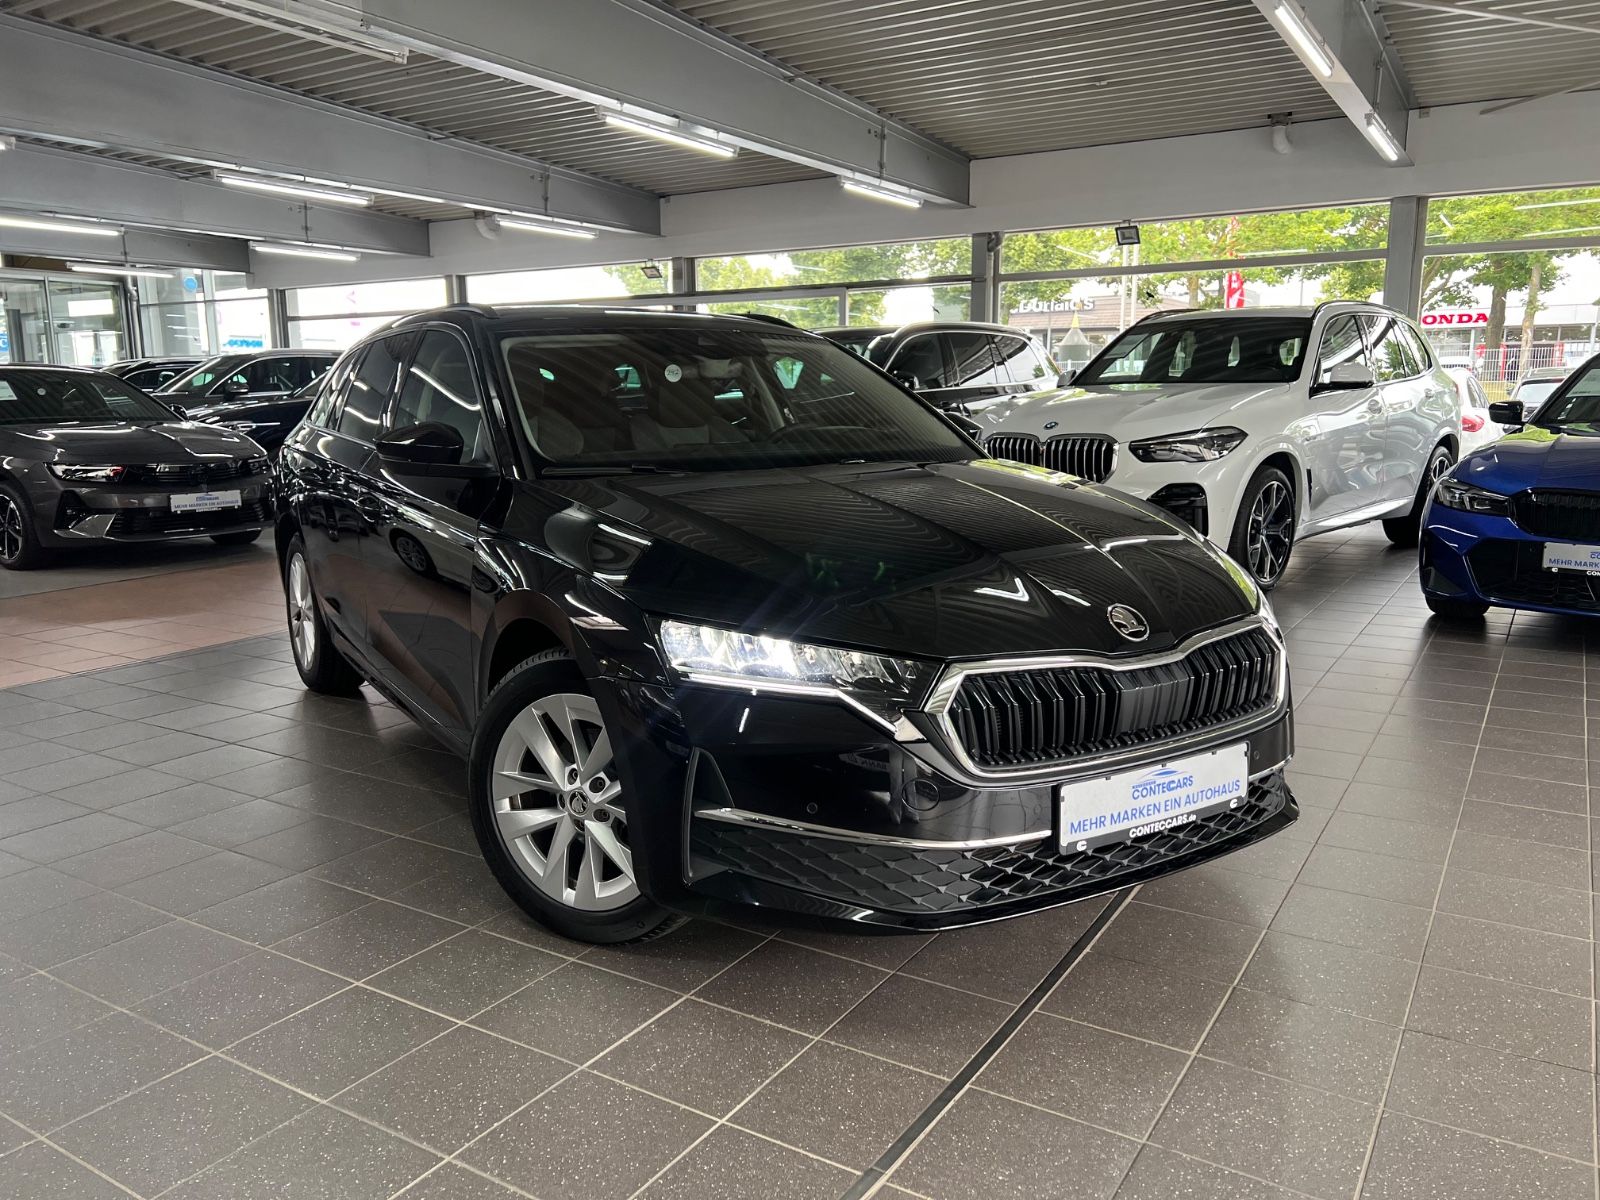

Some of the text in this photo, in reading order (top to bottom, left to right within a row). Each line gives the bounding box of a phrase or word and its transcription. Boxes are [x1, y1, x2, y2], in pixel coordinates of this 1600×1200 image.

[1422, 313, 1489, 325] ONDA
[1549, 558, 1573, 566] MEHR
[1069, 779, 1241, 835] MEHR MARKEN EIN AUTOHAUS
[1129, 813, 1197, 838] CONTECCARS.de
